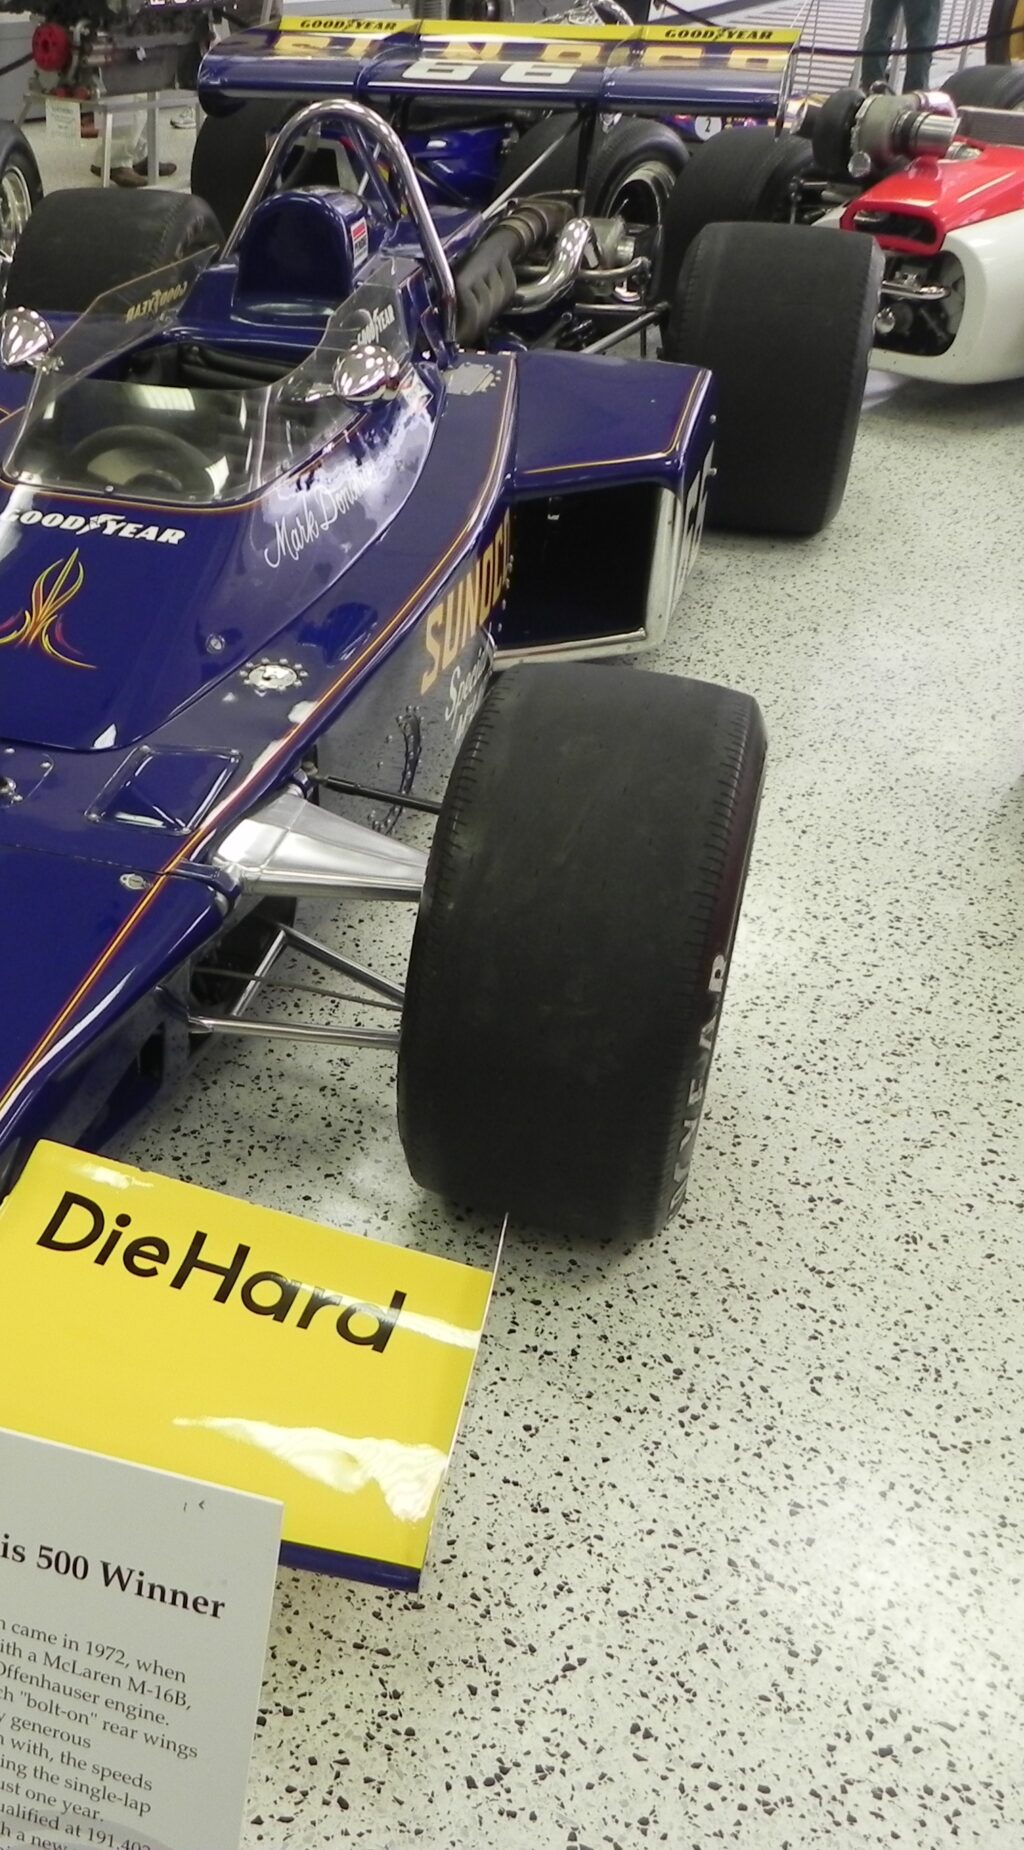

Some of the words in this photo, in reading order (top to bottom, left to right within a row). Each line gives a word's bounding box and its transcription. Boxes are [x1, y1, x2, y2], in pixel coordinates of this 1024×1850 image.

[300, 19, 398, 31] GOODYEAR
[664, 29, 774, 41] GOODYEAR
[704, 117, 713, 133] 2
[0, 509, 186, 545] GOODYEAR
[264, 492, 320, 569] Mark
[36, 1190, 408, 1354] DieHard
[35, 1543, 90, 1581] 500
[99, 1559, 226, 1620] Winner
[10, 1623, 58, 1646] came
[61, 1632, 79, 1653] in
[86, 1640, 130, 1670] 1972,
[136, 1658, 186, 1684] when
[27, 1651, 37, 1664] a
[42, 1650, 122, 1689] McLaren
[127, 1675, 192, 1711] M-16B,
[104, 1697, 170, 1727] engine.
[9, 1715, 92, 1749] generous
[101, 1719, 139, 1740] rear
[143, 1732, 198, 1761] wings
[10, 1737, 54, 1763] with,
[59, 1750, 88, 1771] the
[91, 1763, 153, 1792] speeds
[24, 1788, 58, 1808] one
[60, 1799, 104, 1823] year.
[32, 1765, 61, 1786] the
[63, 1776, 152, 1818] single-lap
[15, 1830, 26, 1843] a
[64, 1823, 82, 1839] at
